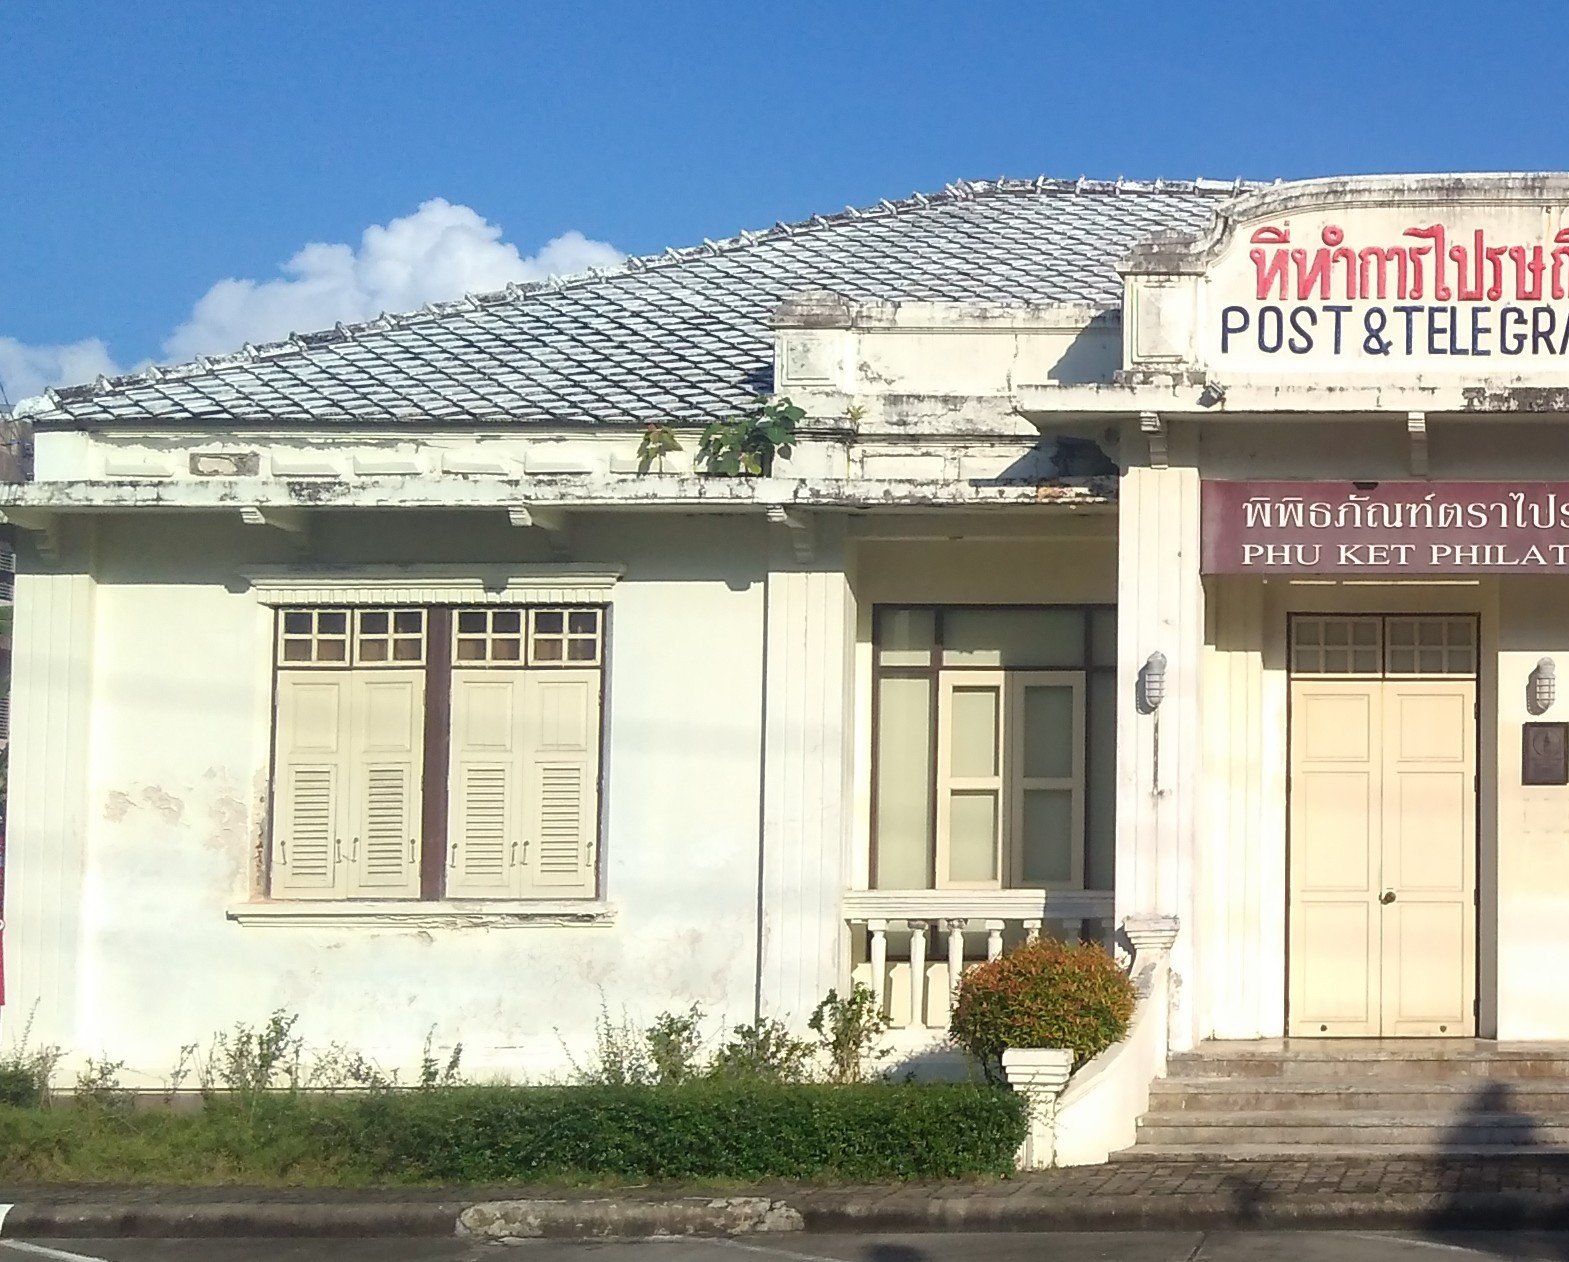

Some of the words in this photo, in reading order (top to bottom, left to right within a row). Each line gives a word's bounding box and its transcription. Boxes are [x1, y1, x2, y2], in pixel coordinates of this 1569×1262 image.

[1221, 305, 1353, 355] POST
[1241, 544, 1322, 565] PHU
[1337, 544, 1416, 565] KET
